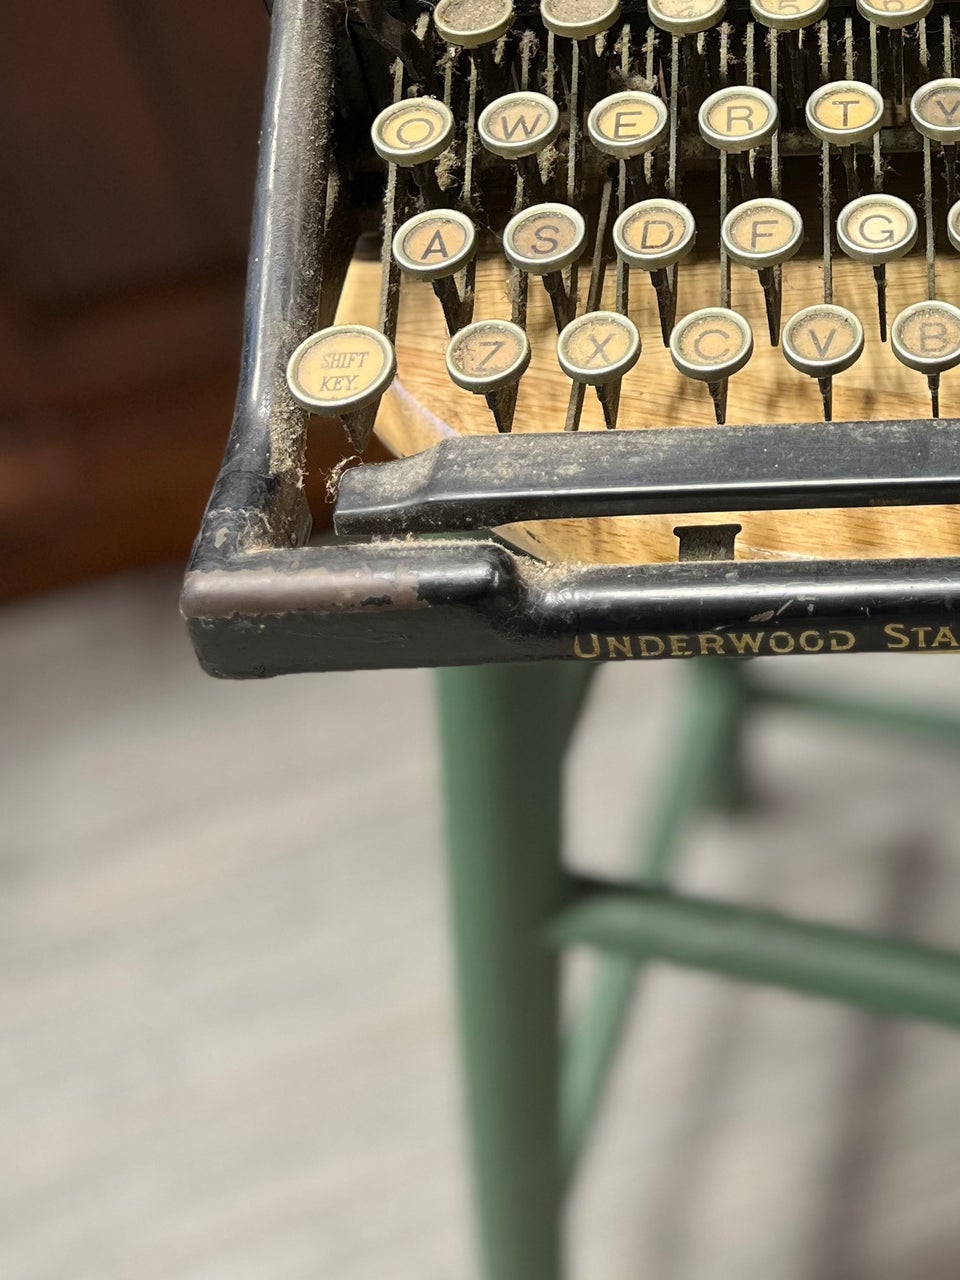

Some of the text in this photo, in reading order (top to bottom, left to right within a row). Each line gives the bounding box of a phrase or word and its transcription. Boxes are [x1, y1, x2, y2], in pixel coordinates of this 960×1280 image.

[501, 113, 542, 141] W
[613, 110, 643, 140] E
[725, 104, 755, 133] R
[831, 99, 861, 128] T
[530, 224, 560, 255] S
[641, 219, 674, 250] D
[750, 219, 779, 249] F
[858, 214, 895, 244] G
[420, 228, 450, 261] A
[585, 332, 617, 365] X
[693, 328, 730, 361] C
[808, 328, 837, 358] V
[919, 321, 948, 353] B
[319, 350, 370, 370] SHIFT
[573, 630, 856, 659] UNDERWOOD
